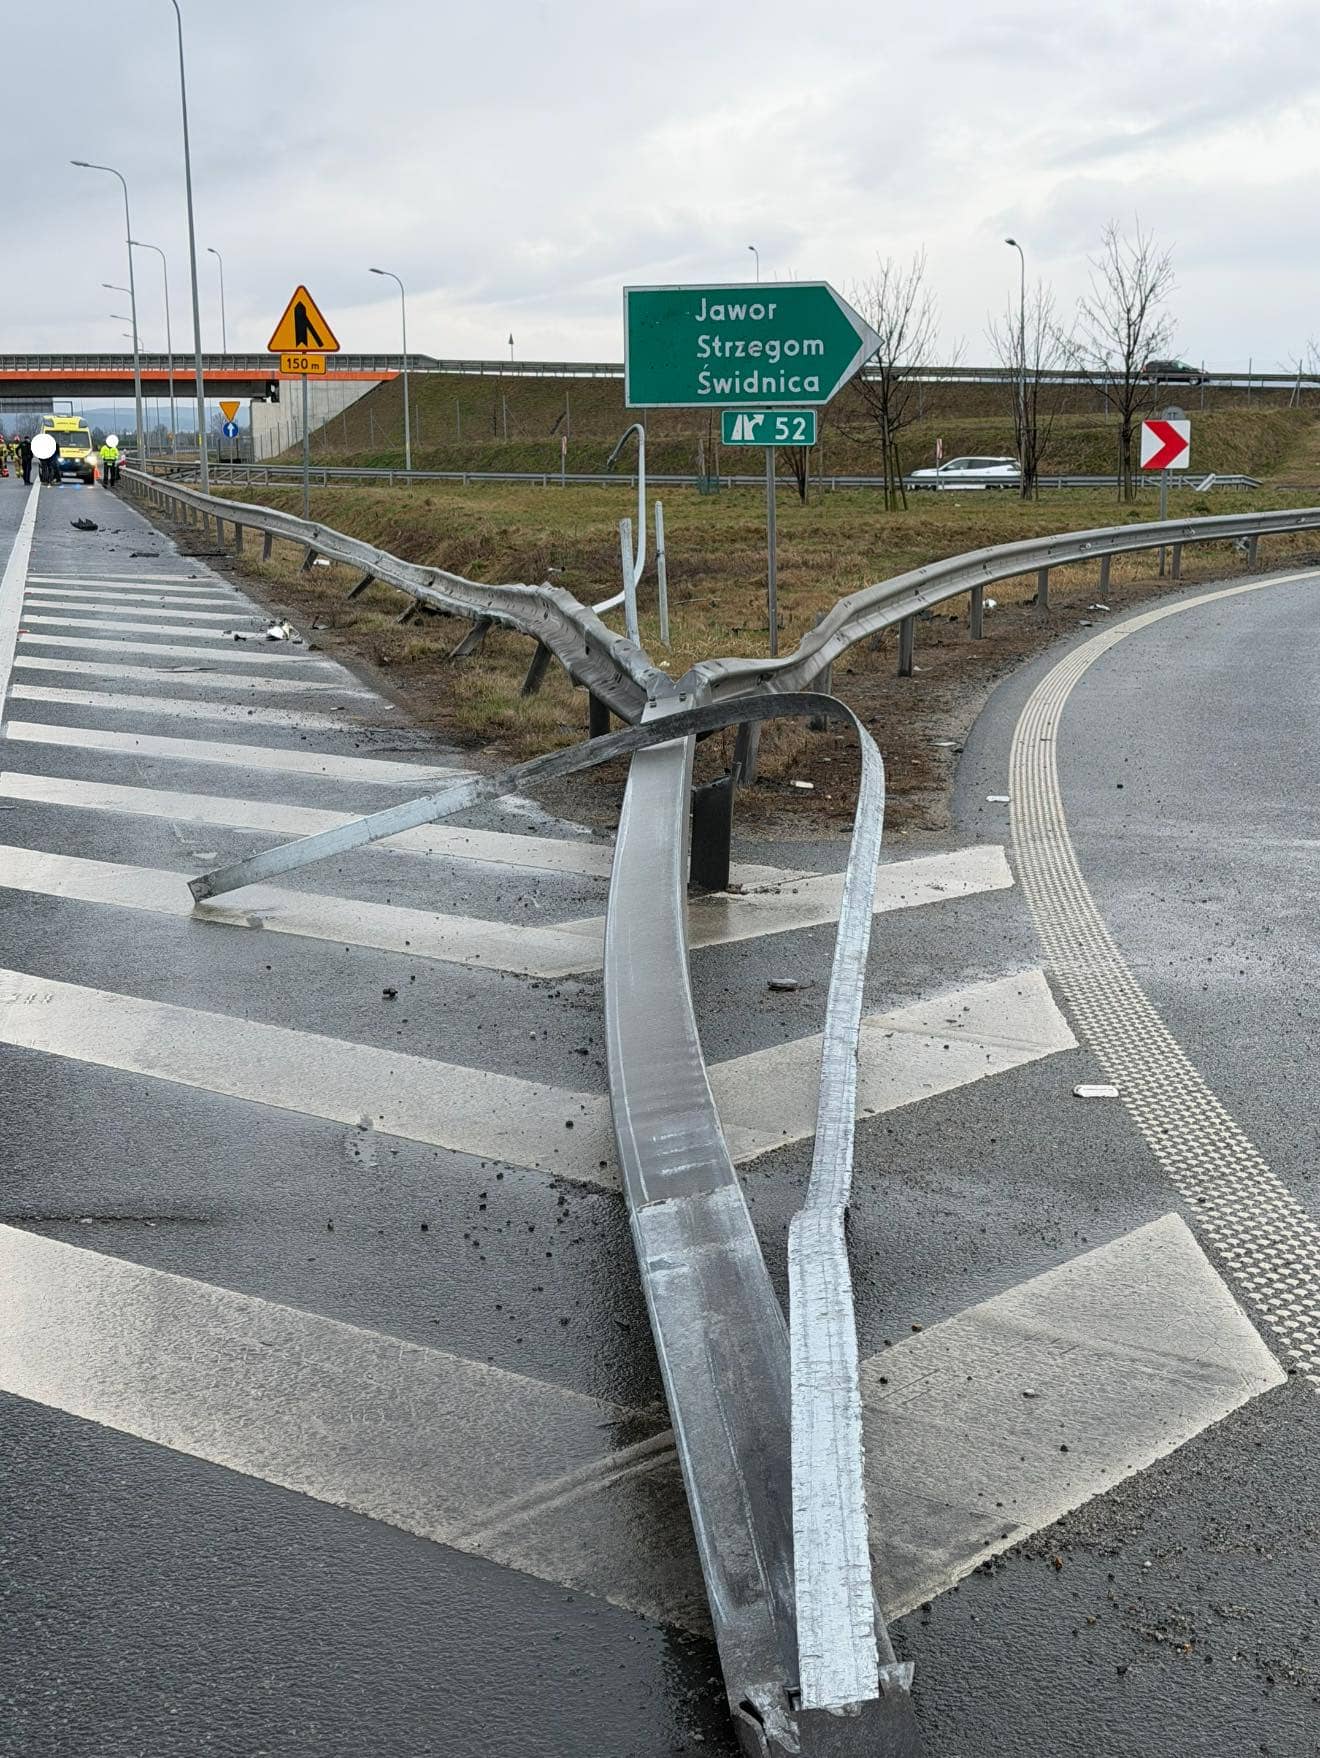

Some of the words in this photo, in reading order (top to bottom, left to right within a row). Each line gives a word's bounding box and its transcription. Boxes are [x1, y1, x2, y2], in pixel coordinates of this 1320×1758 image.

[695, 298, 777, 322] Jawor
[697, 334, 825, 363] Strzegom
[286, 357, 308, 370] 150
[697, 364, 820, 395] Świdnica
[774, 416, 807, 441] 52
